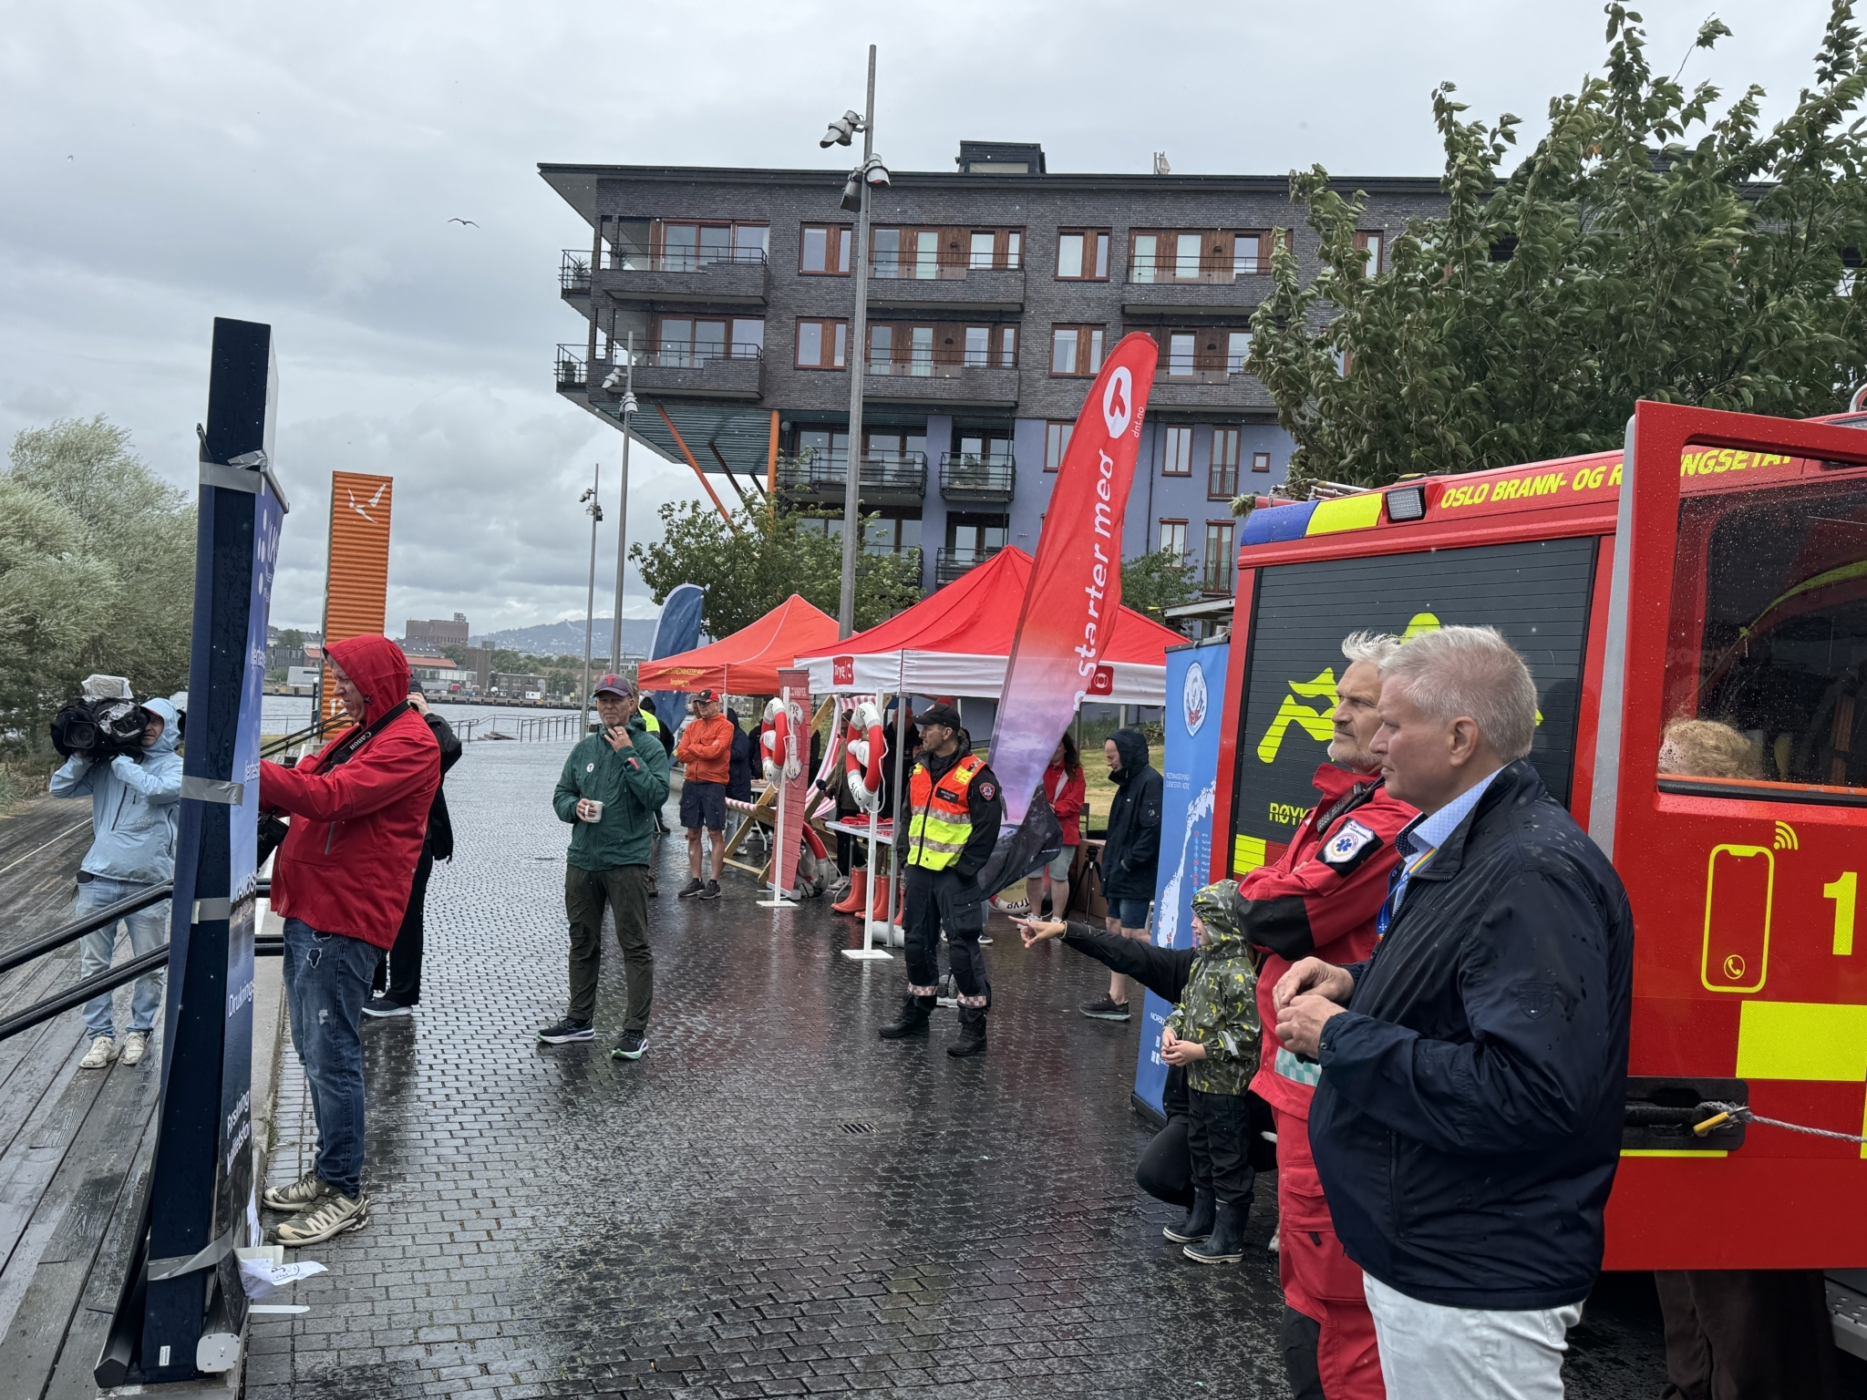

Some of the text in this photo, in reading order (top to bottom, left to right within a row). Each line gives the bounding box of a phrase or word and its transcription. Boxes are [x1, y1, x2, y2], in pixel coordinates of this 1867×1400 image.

[1131, 406, 1145, 438] dnt.no
[1440, 483, 1490, 508] OSLO
[1490, 472, 1567, 502] BRANN-
[1572, 465, 1607, 491] OG
[1074, 543, 1109, 678] starter
[1094, 448, 1114, 539] med
[349, 731, 372, 751] Canon
[1823, 871, 1857, 956] 1
